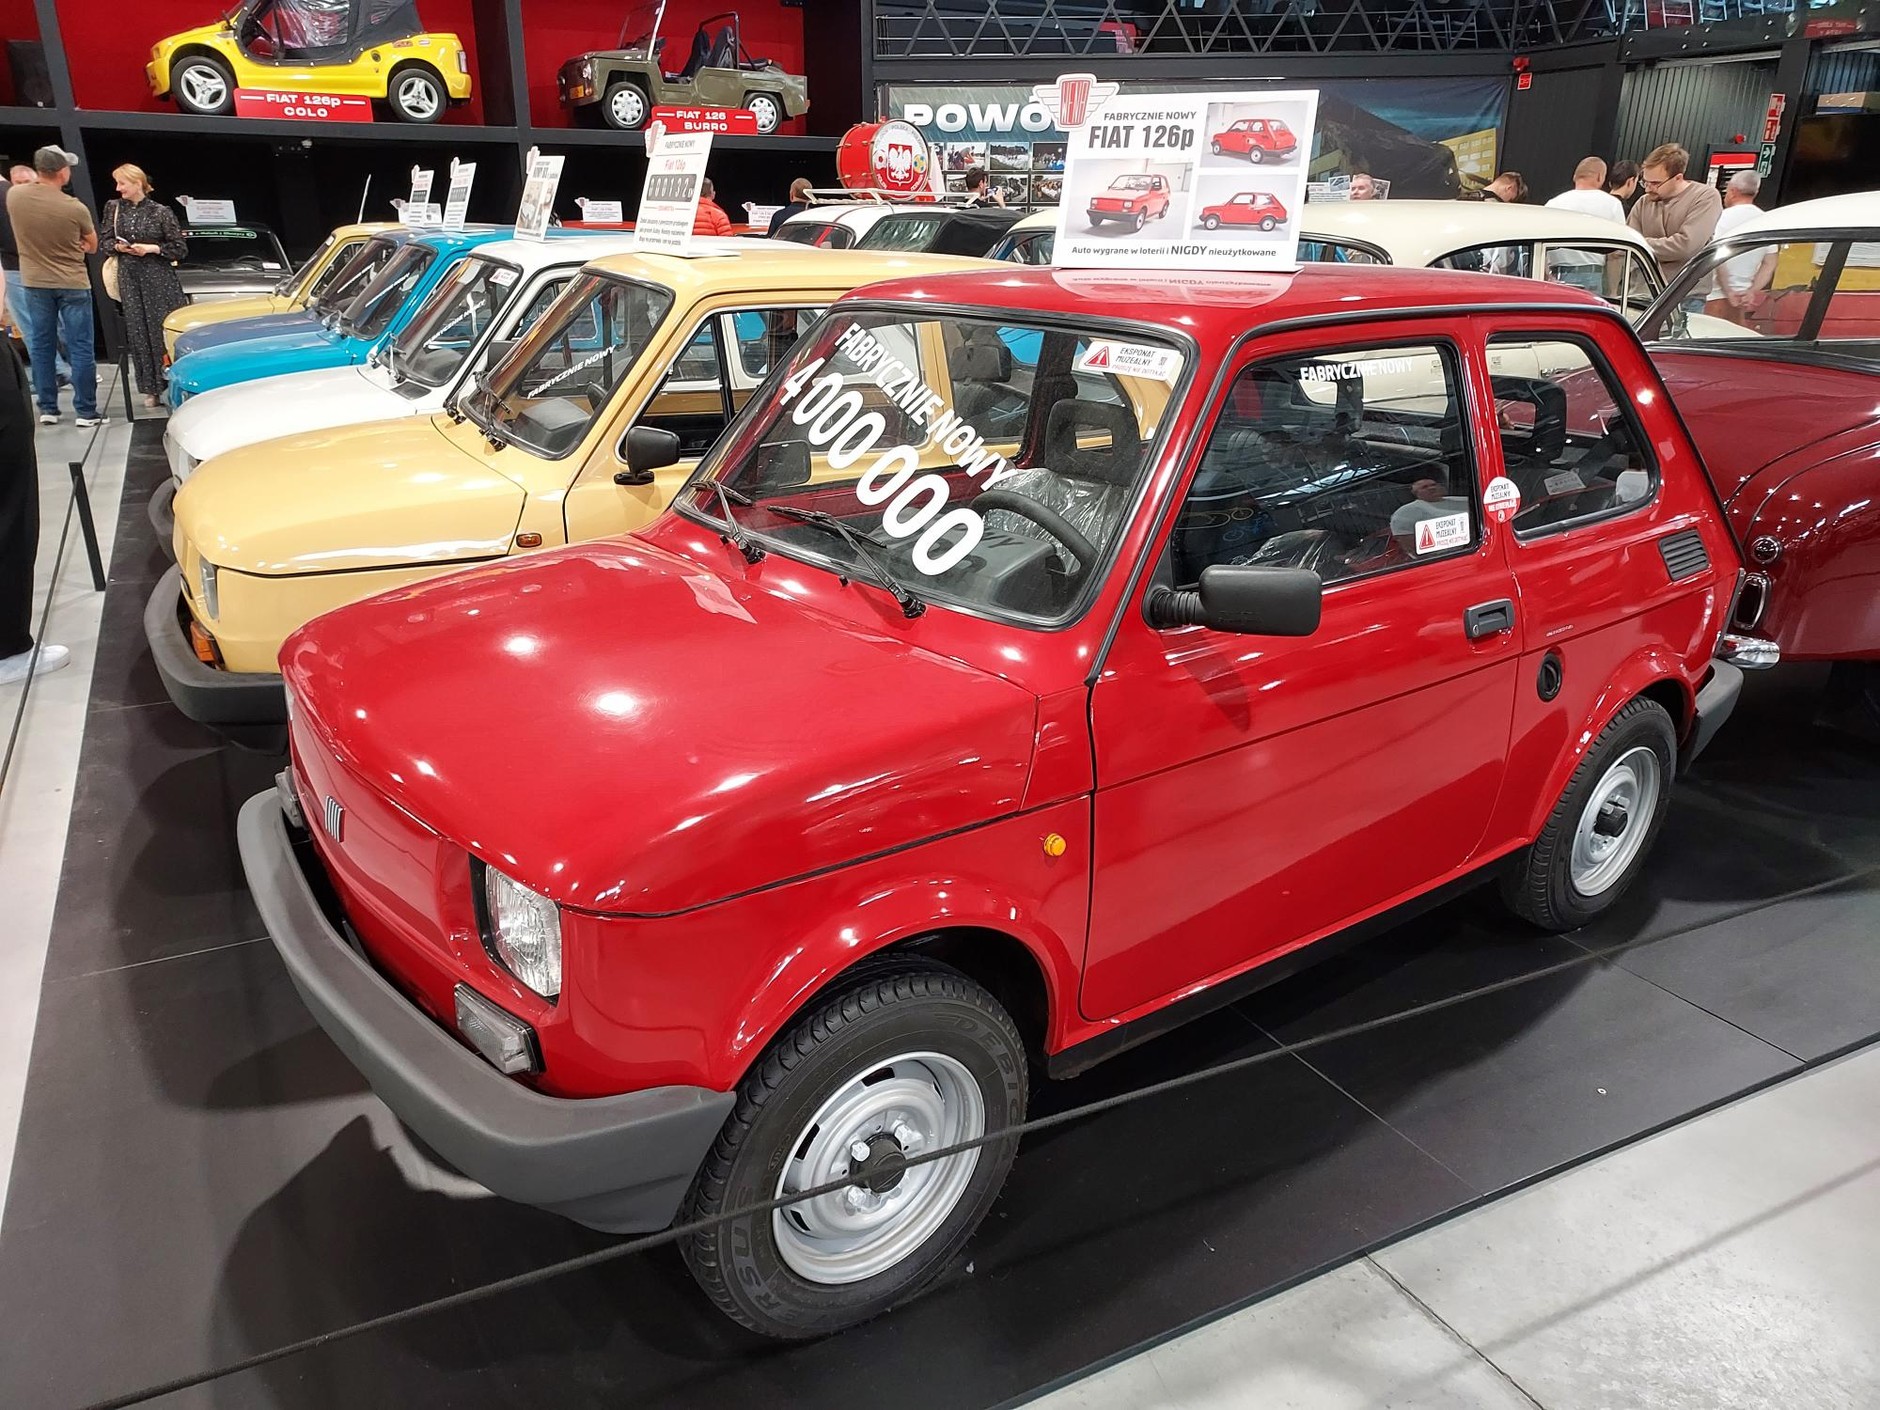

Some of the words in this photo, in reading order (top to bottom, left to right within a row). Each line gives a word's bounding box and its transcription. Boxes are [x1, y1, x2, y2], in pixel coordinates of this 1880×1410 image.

[266, 93, 298, 104] FIAT
[303, 95, 341, 107] 126p
[283, 106, 328, 118] COLO
[676, 110, 700, 119] FIAT
[705, 111, 726, 120] 126
[1103, 112, 1163, 121] FABRYCZNIE
[1165, 111, 1197, 120] NOWY
[683, 121, 728, 131] BURRO
[1088, 125, 1135, 149] FIAT
[1142, 124, 1195, 151] 126p
[1071, 246, 1092, 254] Auto
[1093, 247, 1129, 256] wygrane
[1140, 247, 1165, 255] loterii
[1171, 245, 1208, 255] NIGDY
[1208, 247, 1277, 258] nieużytkowane
[1120, 347, 1156, 358] EKSPONAT
[1116, 355, 1153, 366] MUZEALNY
[527, 361, 585, 400] FABRYCZNIE
[584, 344, 617, 367] NOWY
[1300, 362, 1377, 382] FABRYCZNIE
[1379, 359, 1413, 373] NOWY
[834, 322, 945, 426] FABRYCZNIE
[926, 408, 1018, 492] NOWY
[855, 444, 985, 576] 000
